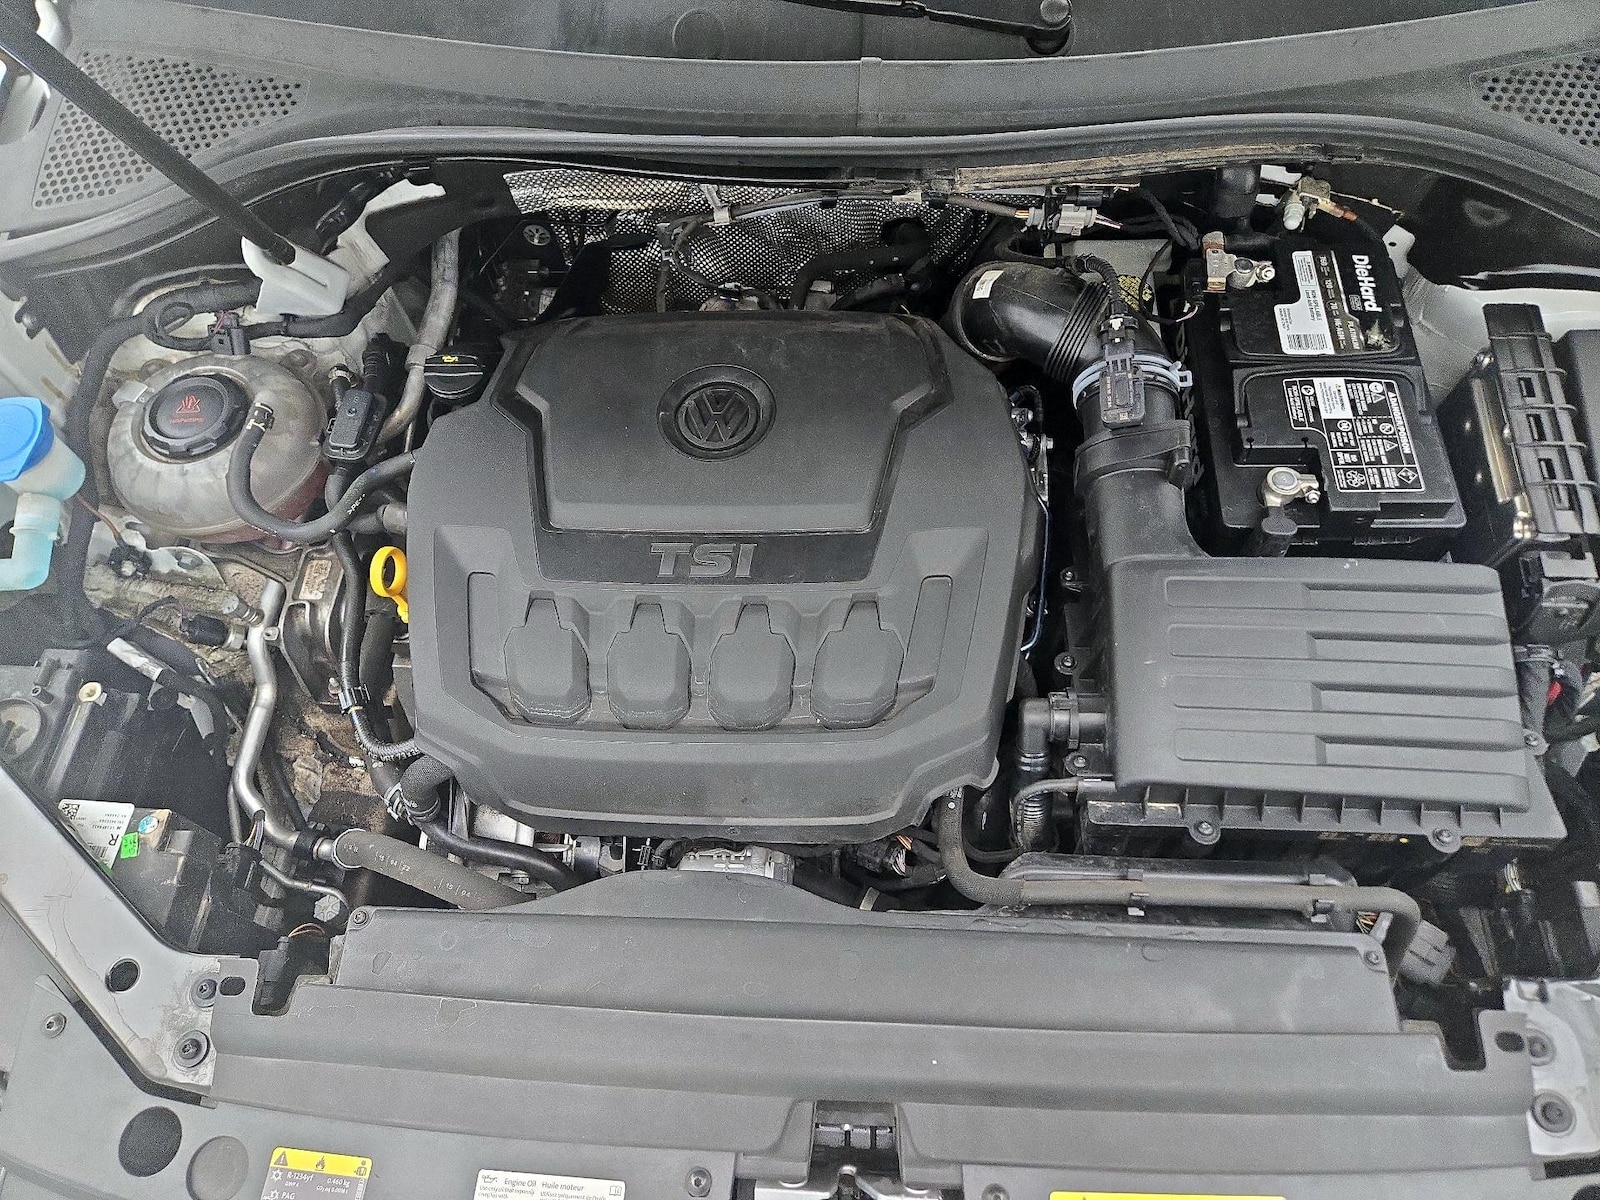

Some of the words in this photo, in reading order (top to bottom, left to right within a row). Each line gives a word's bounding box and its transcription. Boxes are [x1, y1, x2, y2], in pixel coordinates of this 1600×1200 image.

[1352, 254, 1383, 313] DieHard
[1347, 320, 1361, 350] PLATINUM
[650, 542, 758, 578] TSI
[108, 833, 119, 846] R
[286, 1171, 314, 1184] R-1234yf
[326, 1177, 344, 1186] 0.460
[343, 1180, 351, 1189] kg
[504, 1177, 527, 1188] Engine
[527, 1179, 537, 1187] Oil
[541, 1181, 559, 1190] Huile
[559, 1183, 585, 1191] moteur
[281, 1191, 296, 1200] PAG
